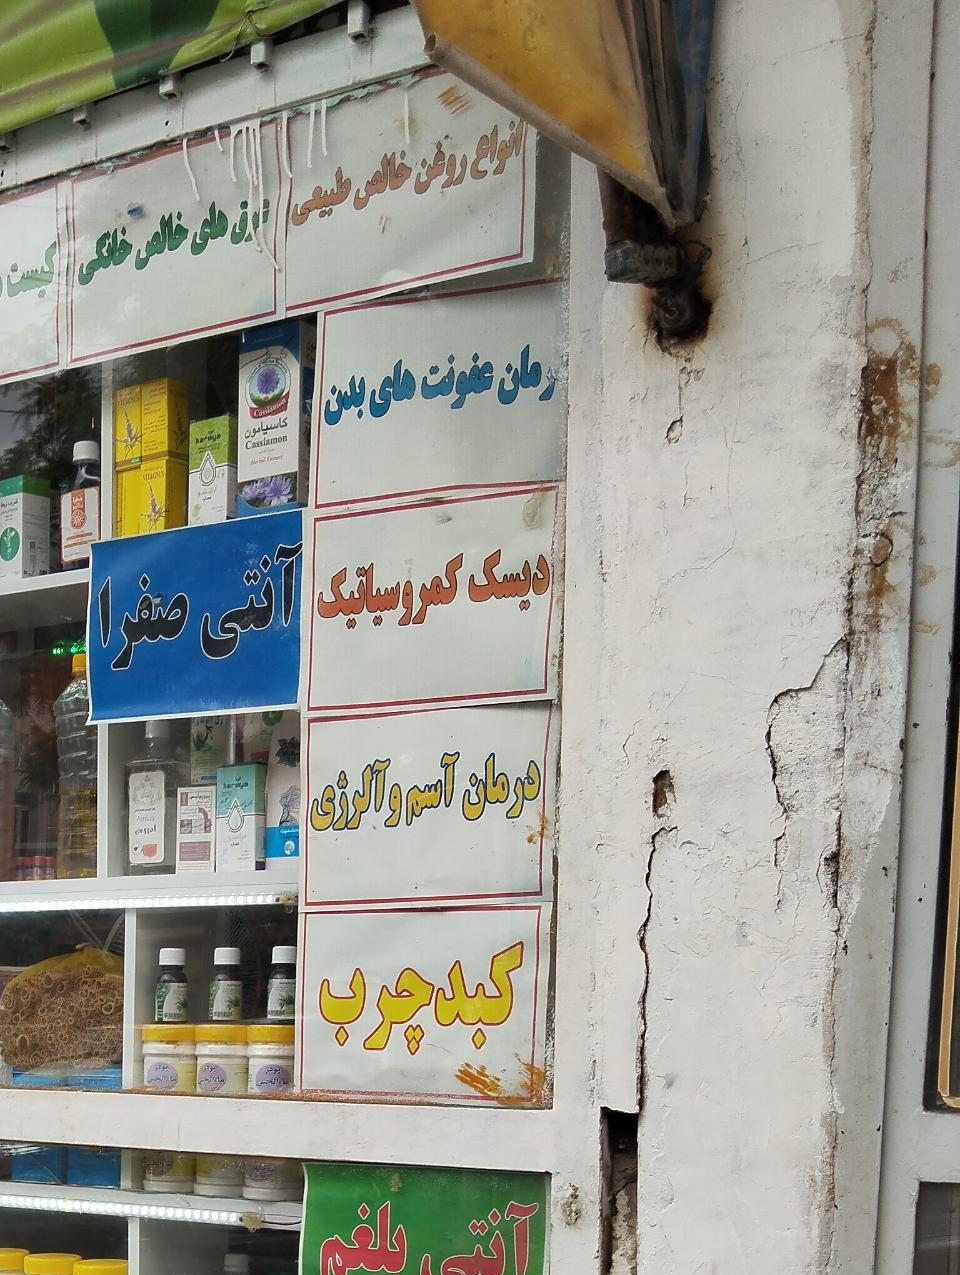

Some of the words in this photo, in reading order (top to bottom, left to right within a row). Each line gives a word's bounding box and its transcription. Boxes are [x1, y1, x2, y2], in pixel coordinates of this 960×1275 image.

[353, 150, 412, 210] خالص
[414, 141, 467, 194] روغن
[470, 120, 523, 180] انواع
[292, 166, 351, 226] طبیعی
[78, 226, 133, 285] خانگی
[134, 211, 189, 270] خالص
[191, 201, 228, 255] های
[6, 241, 57, 298] کیست
[324, 375, 365, 426] بدن
[369, 359, 416, 418] های
[421, 352, 494, 409] عفونت
[245, 435, 288, 450] Cassiamon
[200, 541, 303, 659] آنتی
[412, 553, 464, 624] کمر
[468, 549, 550, 611] دیسک
[98, 574, 189, 670] صفرا
[406, 751, 460, 826] آسم
[462, 752, 541, 821] درمان
[319, 968, 434, 1055] چرب
[434, 941, 525, 1049] کبد
